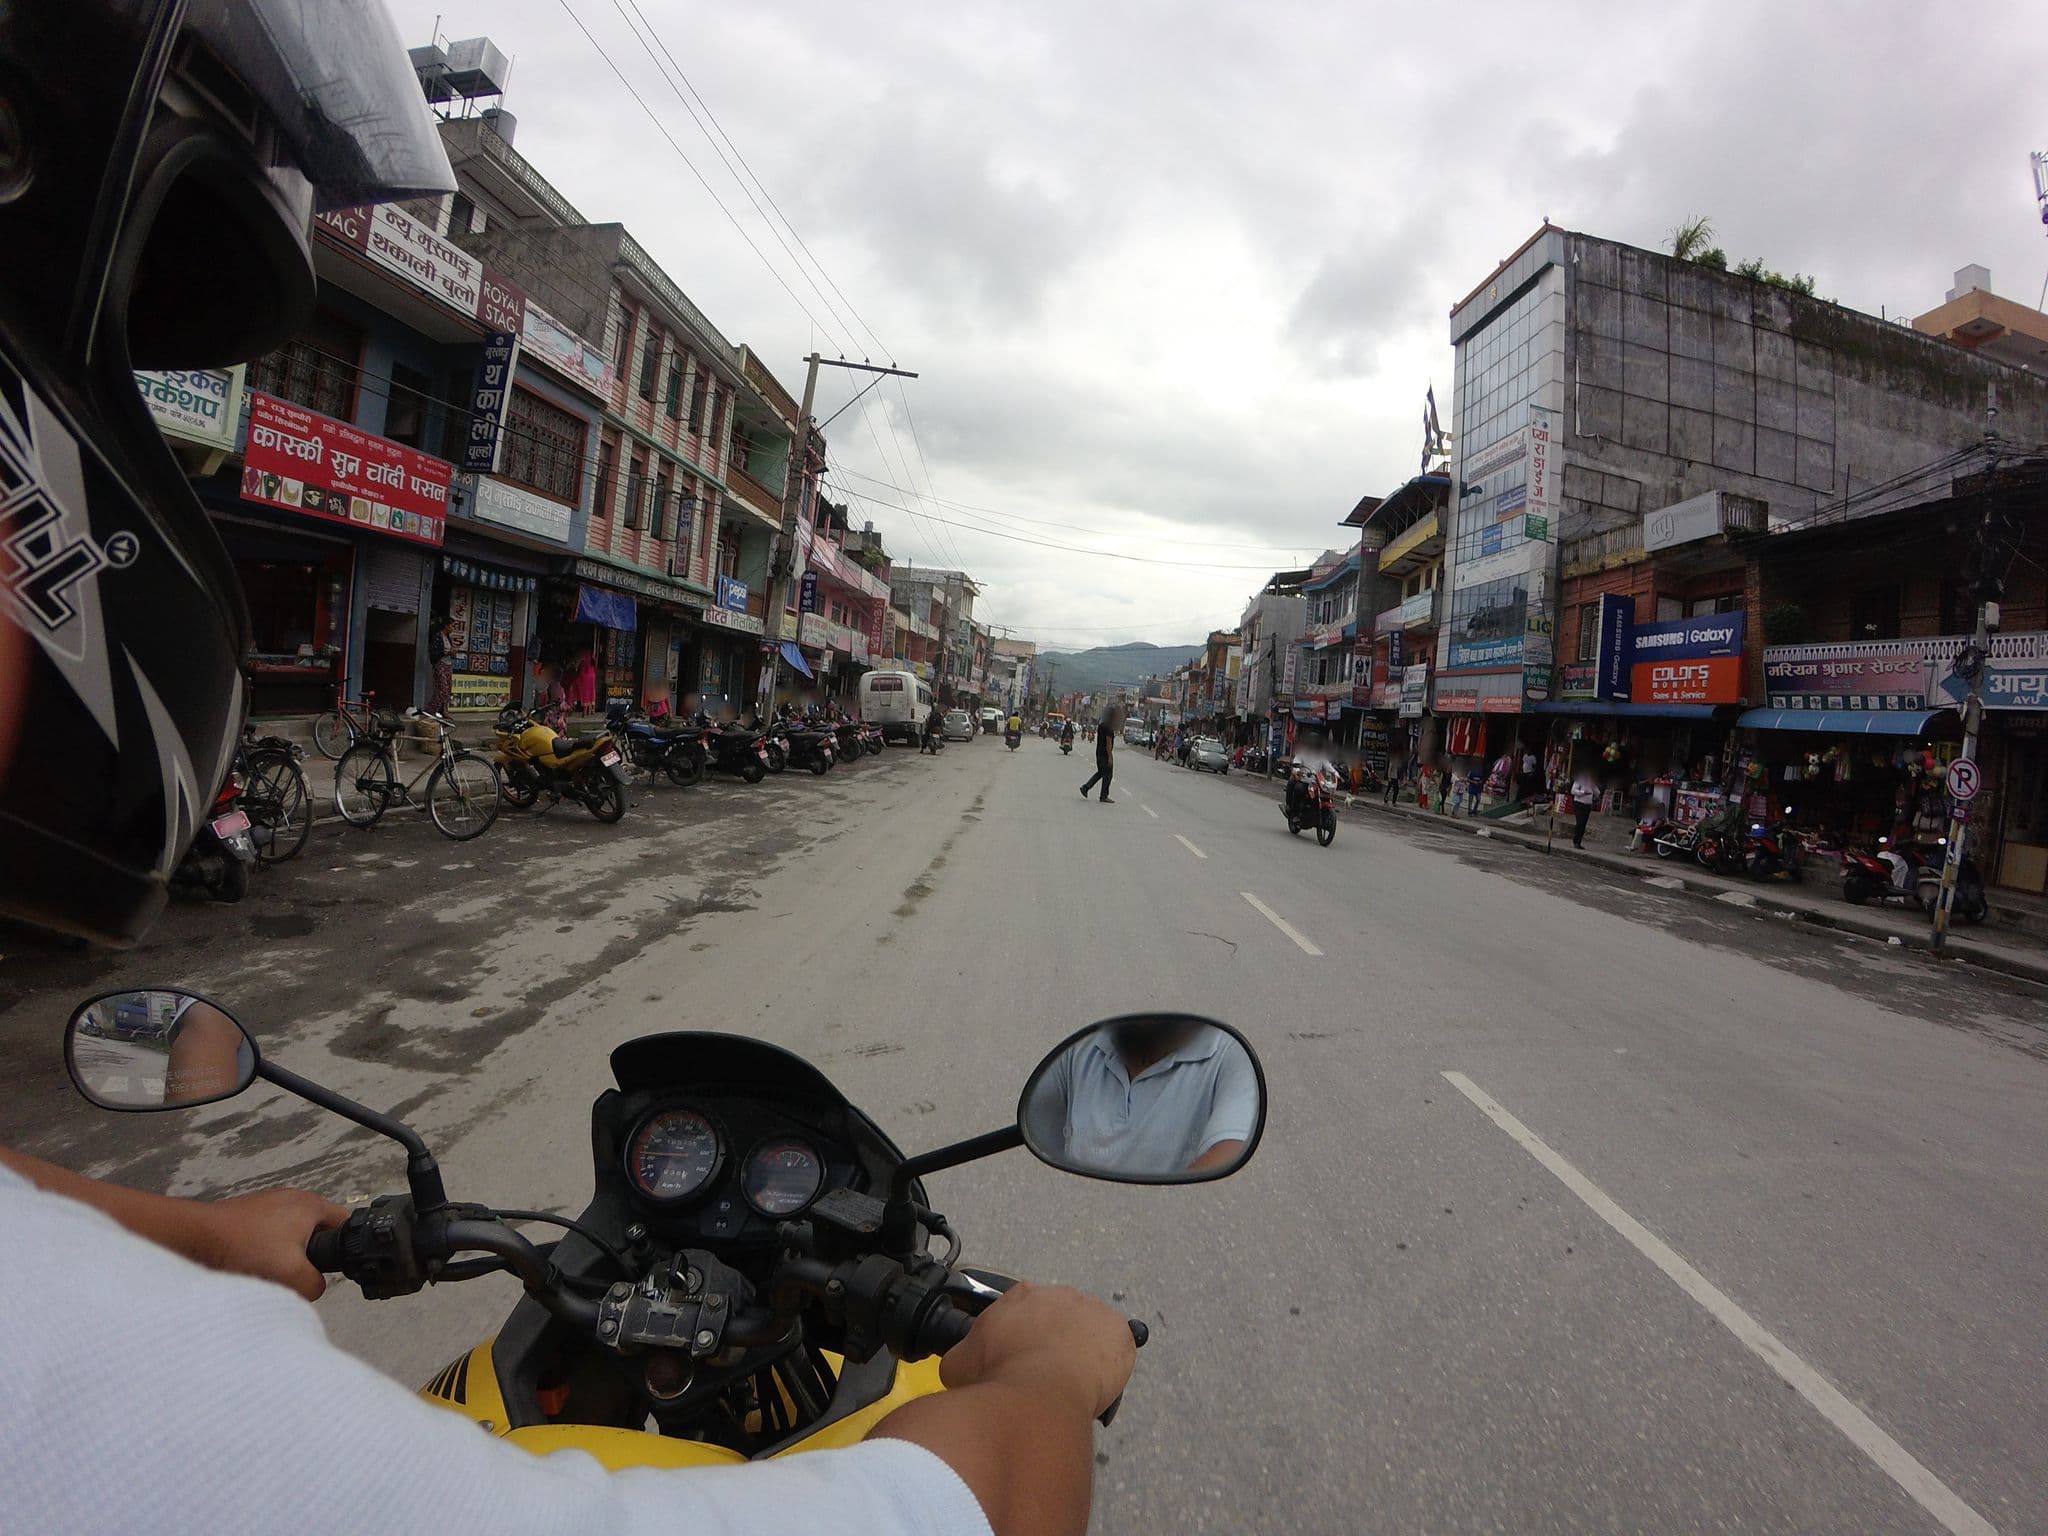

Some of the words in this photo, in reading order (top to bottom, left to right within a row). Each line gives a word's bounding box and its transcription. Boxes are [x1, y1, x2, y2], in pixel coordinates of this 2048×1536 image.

[385, 210, 414, 245] न्यू
[372, 231, 437, 282] थकाली
[483, 280, 521, 317] ROYAL
[486, 305, 516, 333] STAG
[252, 423, 324, 465] कास्की
[330, 448, 361, 479] सुन
[366, 462, 405, 490] चाँदी
[411, 474, 448, 502] पसल
[1615, 608, 1624, 652] SAMSUNG
[1635, 631, 1684, 649] SAMSUNG
[1690, 627, 1734, 645] Galaxy
[1610, 654, 1621, 686] Galaxy
[1767, 662, 1818, 677] मरियम
[1869, 658, 1920, 675] सेन्टर
[1652, 680, 1708, 689] MOBILE
[1652, 691, 1669, 700] Sales
[1672, 691, 1678, 699] &
[1680, 690, 1705, 700] Service
[1958, 767, 1972, 789] P
